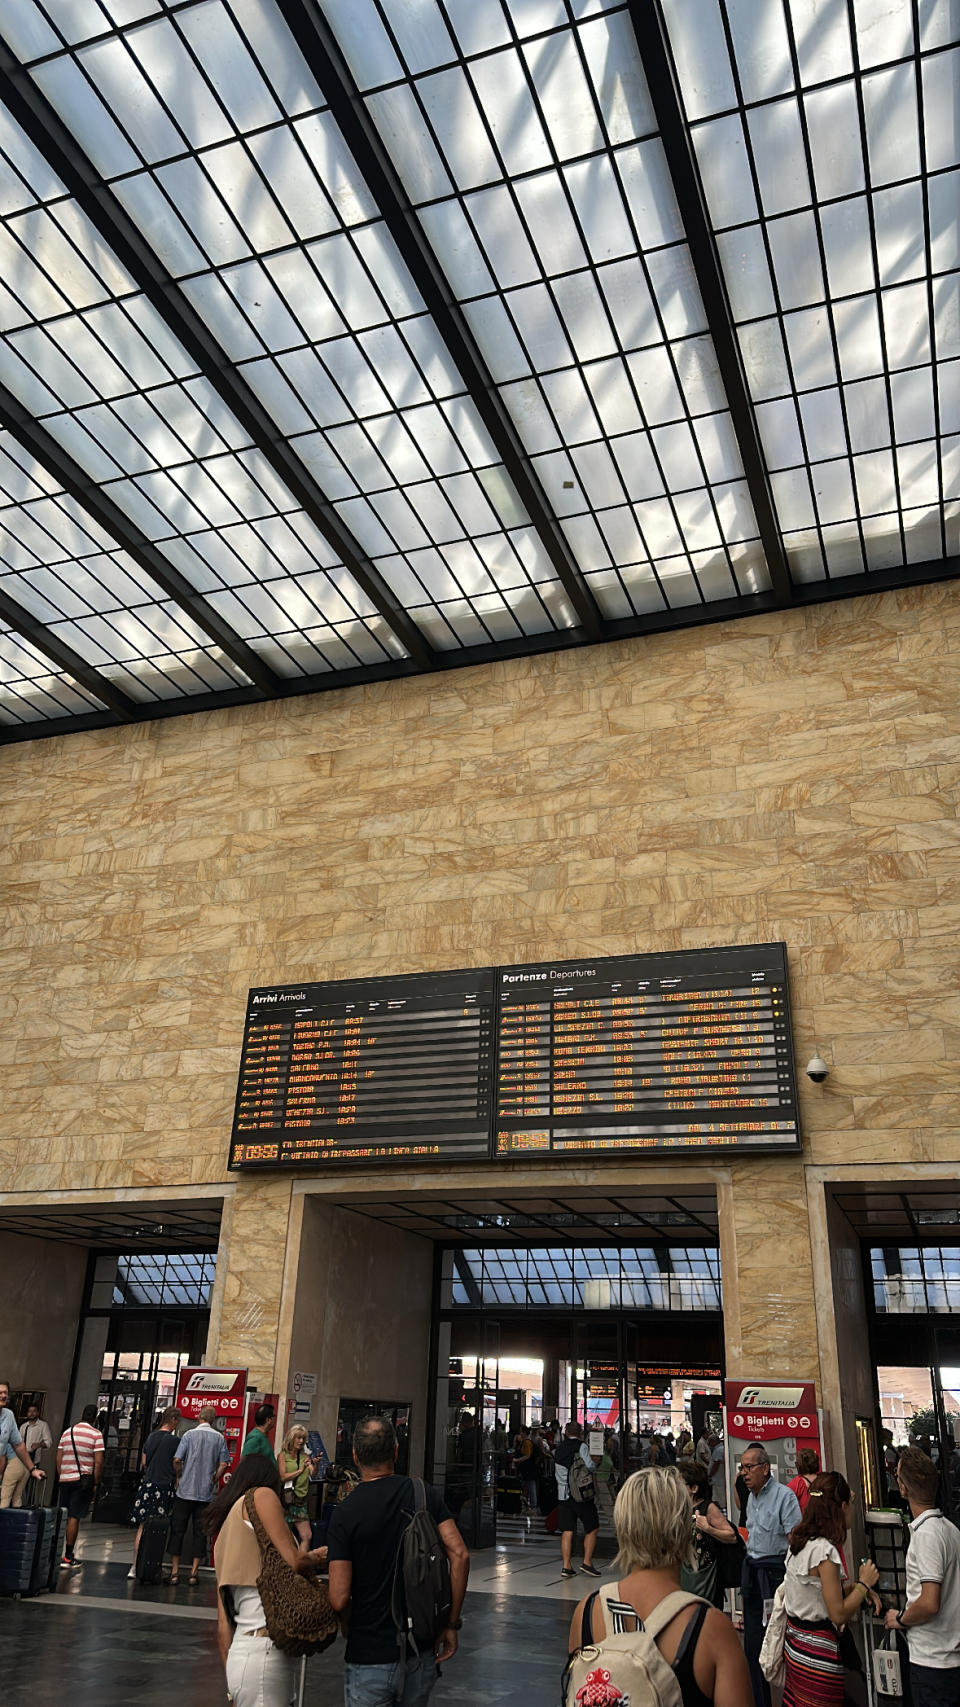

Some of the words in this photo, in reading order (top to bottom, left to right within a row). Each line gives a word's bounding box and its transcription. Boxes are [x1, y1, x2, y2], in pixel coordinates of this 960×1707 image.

[502, 972, 547, 983] Partenze
[550, 969, 596, 980] Departures
[253, 994, 278, 1004] Arrivi
[279, 992, 306, 1001] Arrivals
[191, 1397, 219, 1407] Biglietti
[748, 1416, 784, 1426] Biglietti
